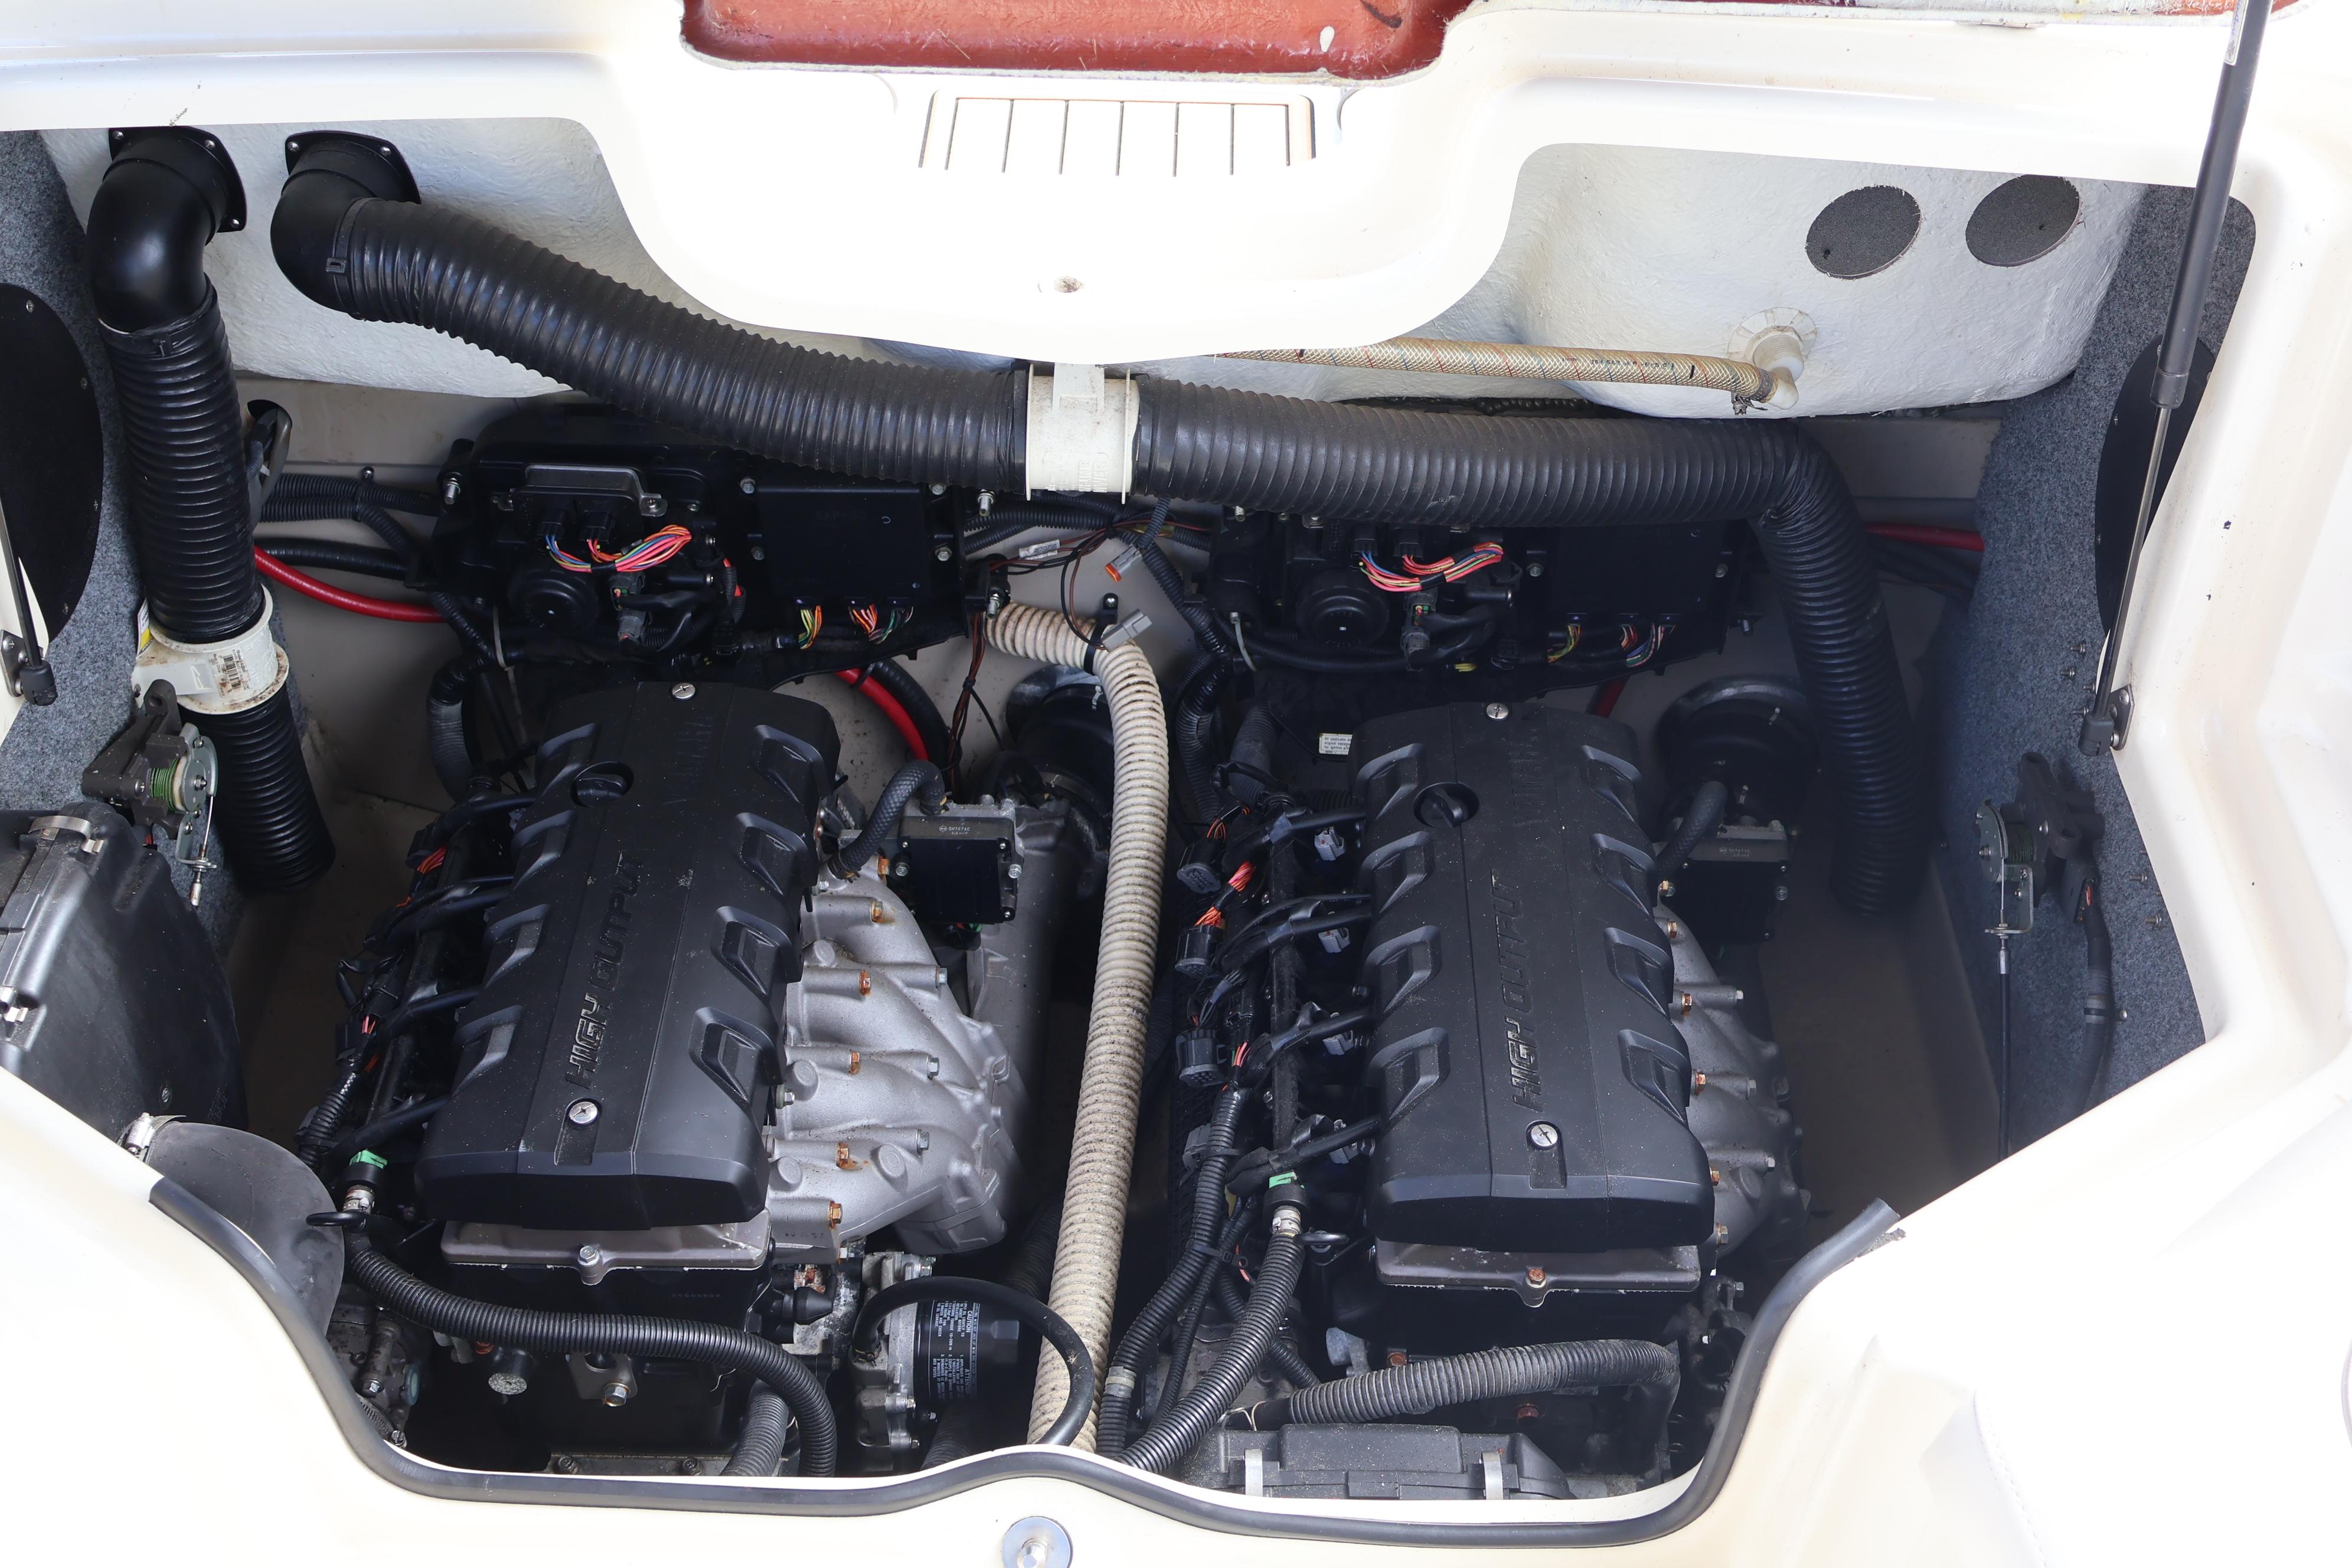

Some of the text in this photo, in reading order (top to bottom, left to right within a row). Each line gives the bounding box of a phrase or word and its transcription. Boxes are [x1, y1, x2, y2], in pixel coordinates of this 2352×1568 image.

[565, 850, 643, 1090] HIGH OUTPUT
[1491, 869, 1533, 1013] OUTPUT
[1505, 1014, 1543, 1113] HIGH
